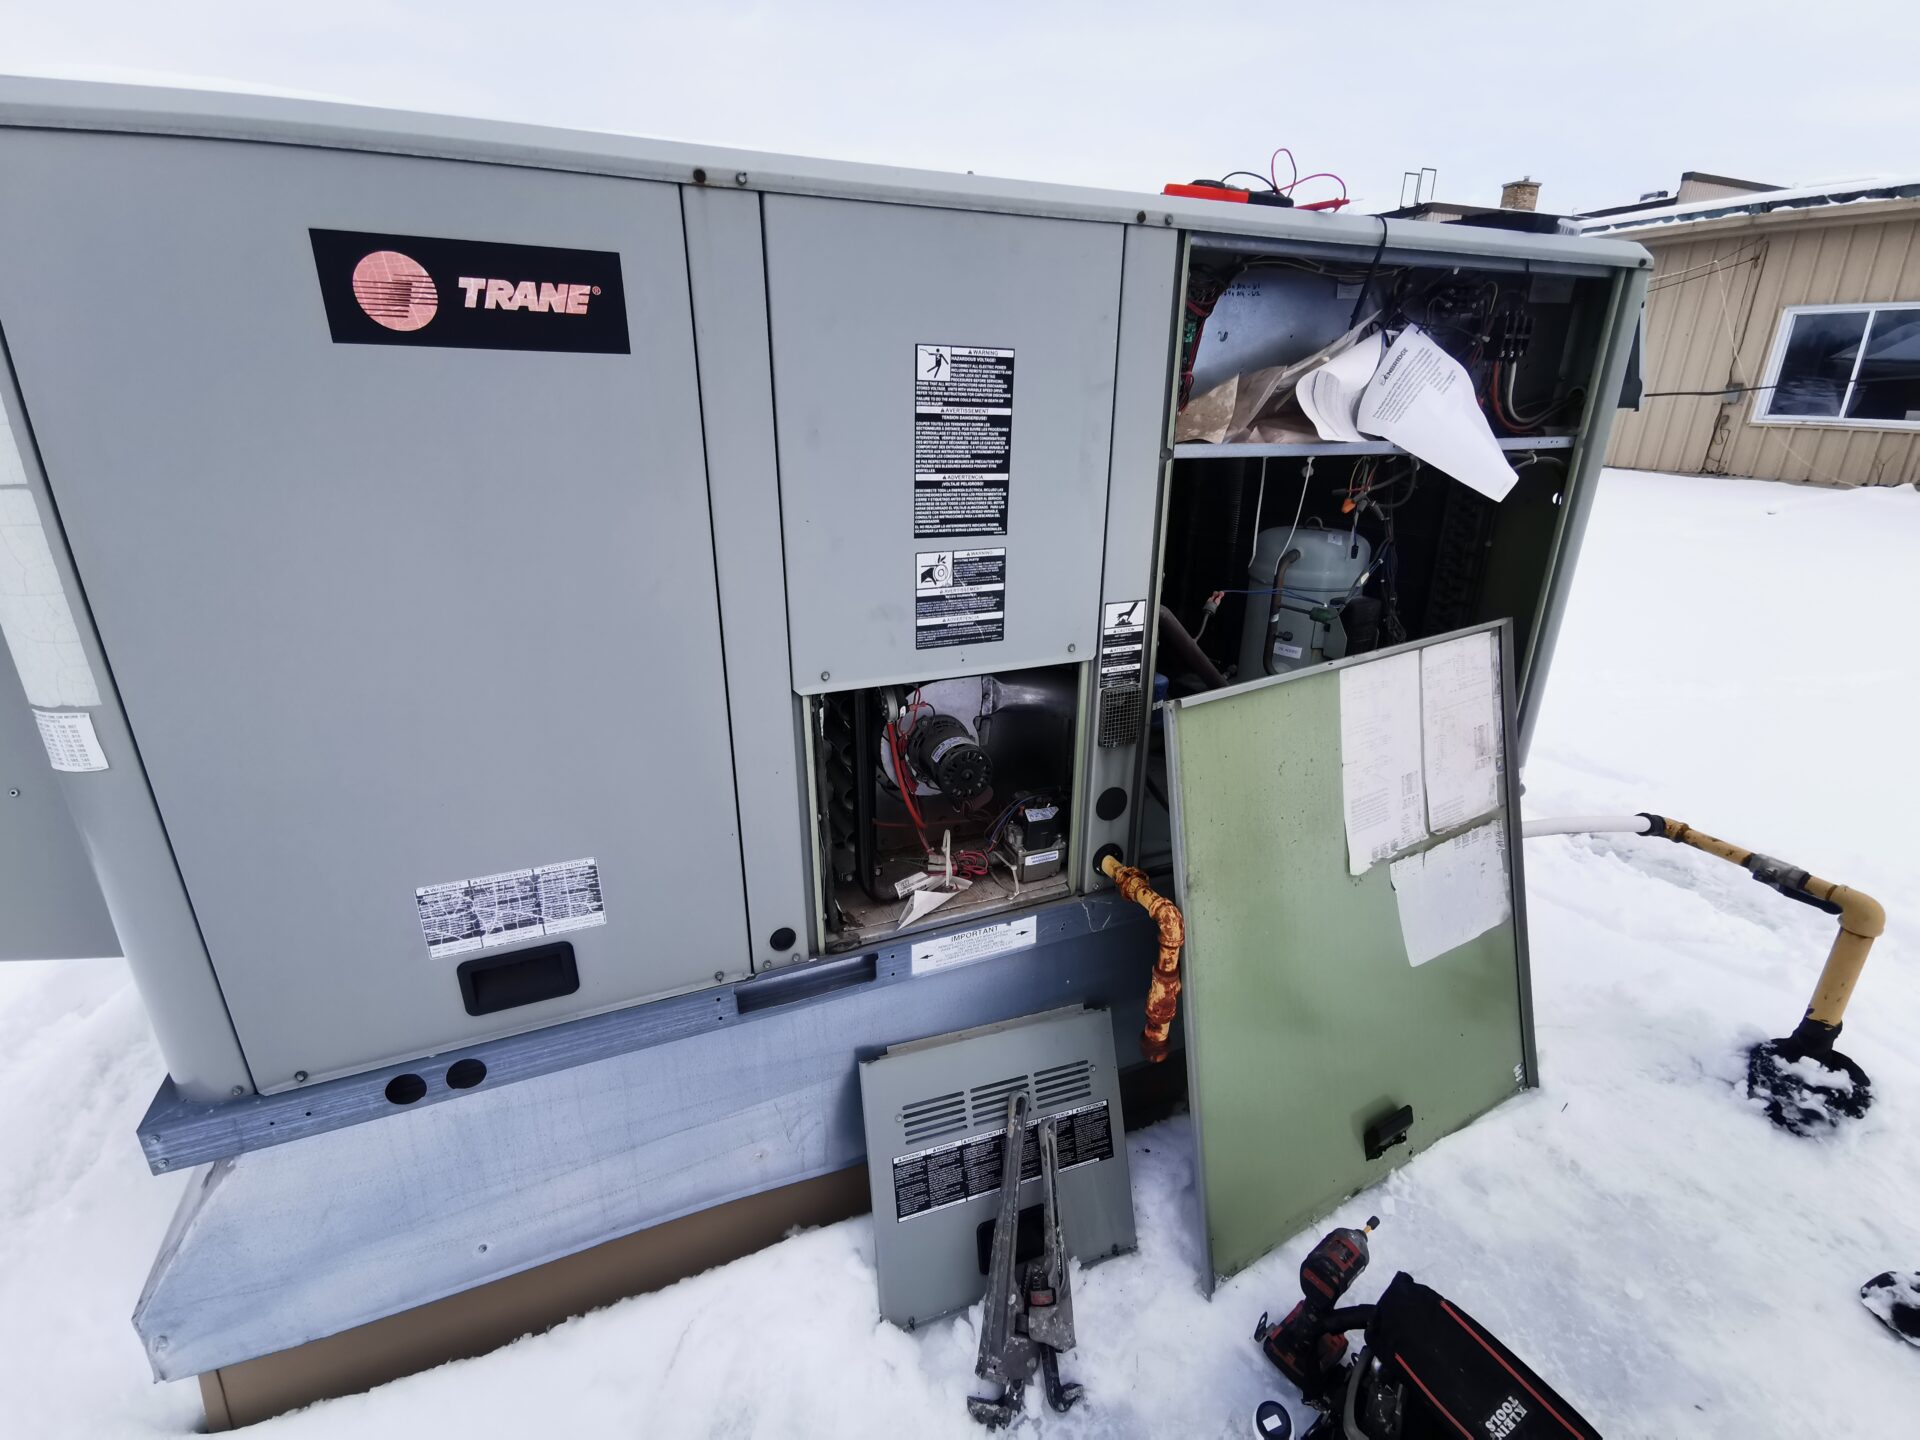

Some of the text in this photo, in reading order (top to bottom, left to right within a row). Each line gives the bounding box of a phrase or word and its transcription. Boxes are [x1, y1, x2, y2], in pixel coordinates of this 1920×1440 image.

[951, 926, 998, 943] IMPORTANT
[1485, 1396, 1519, 1432] TOOLS
[1494, 1404, 1528, 1440] KLEIN
